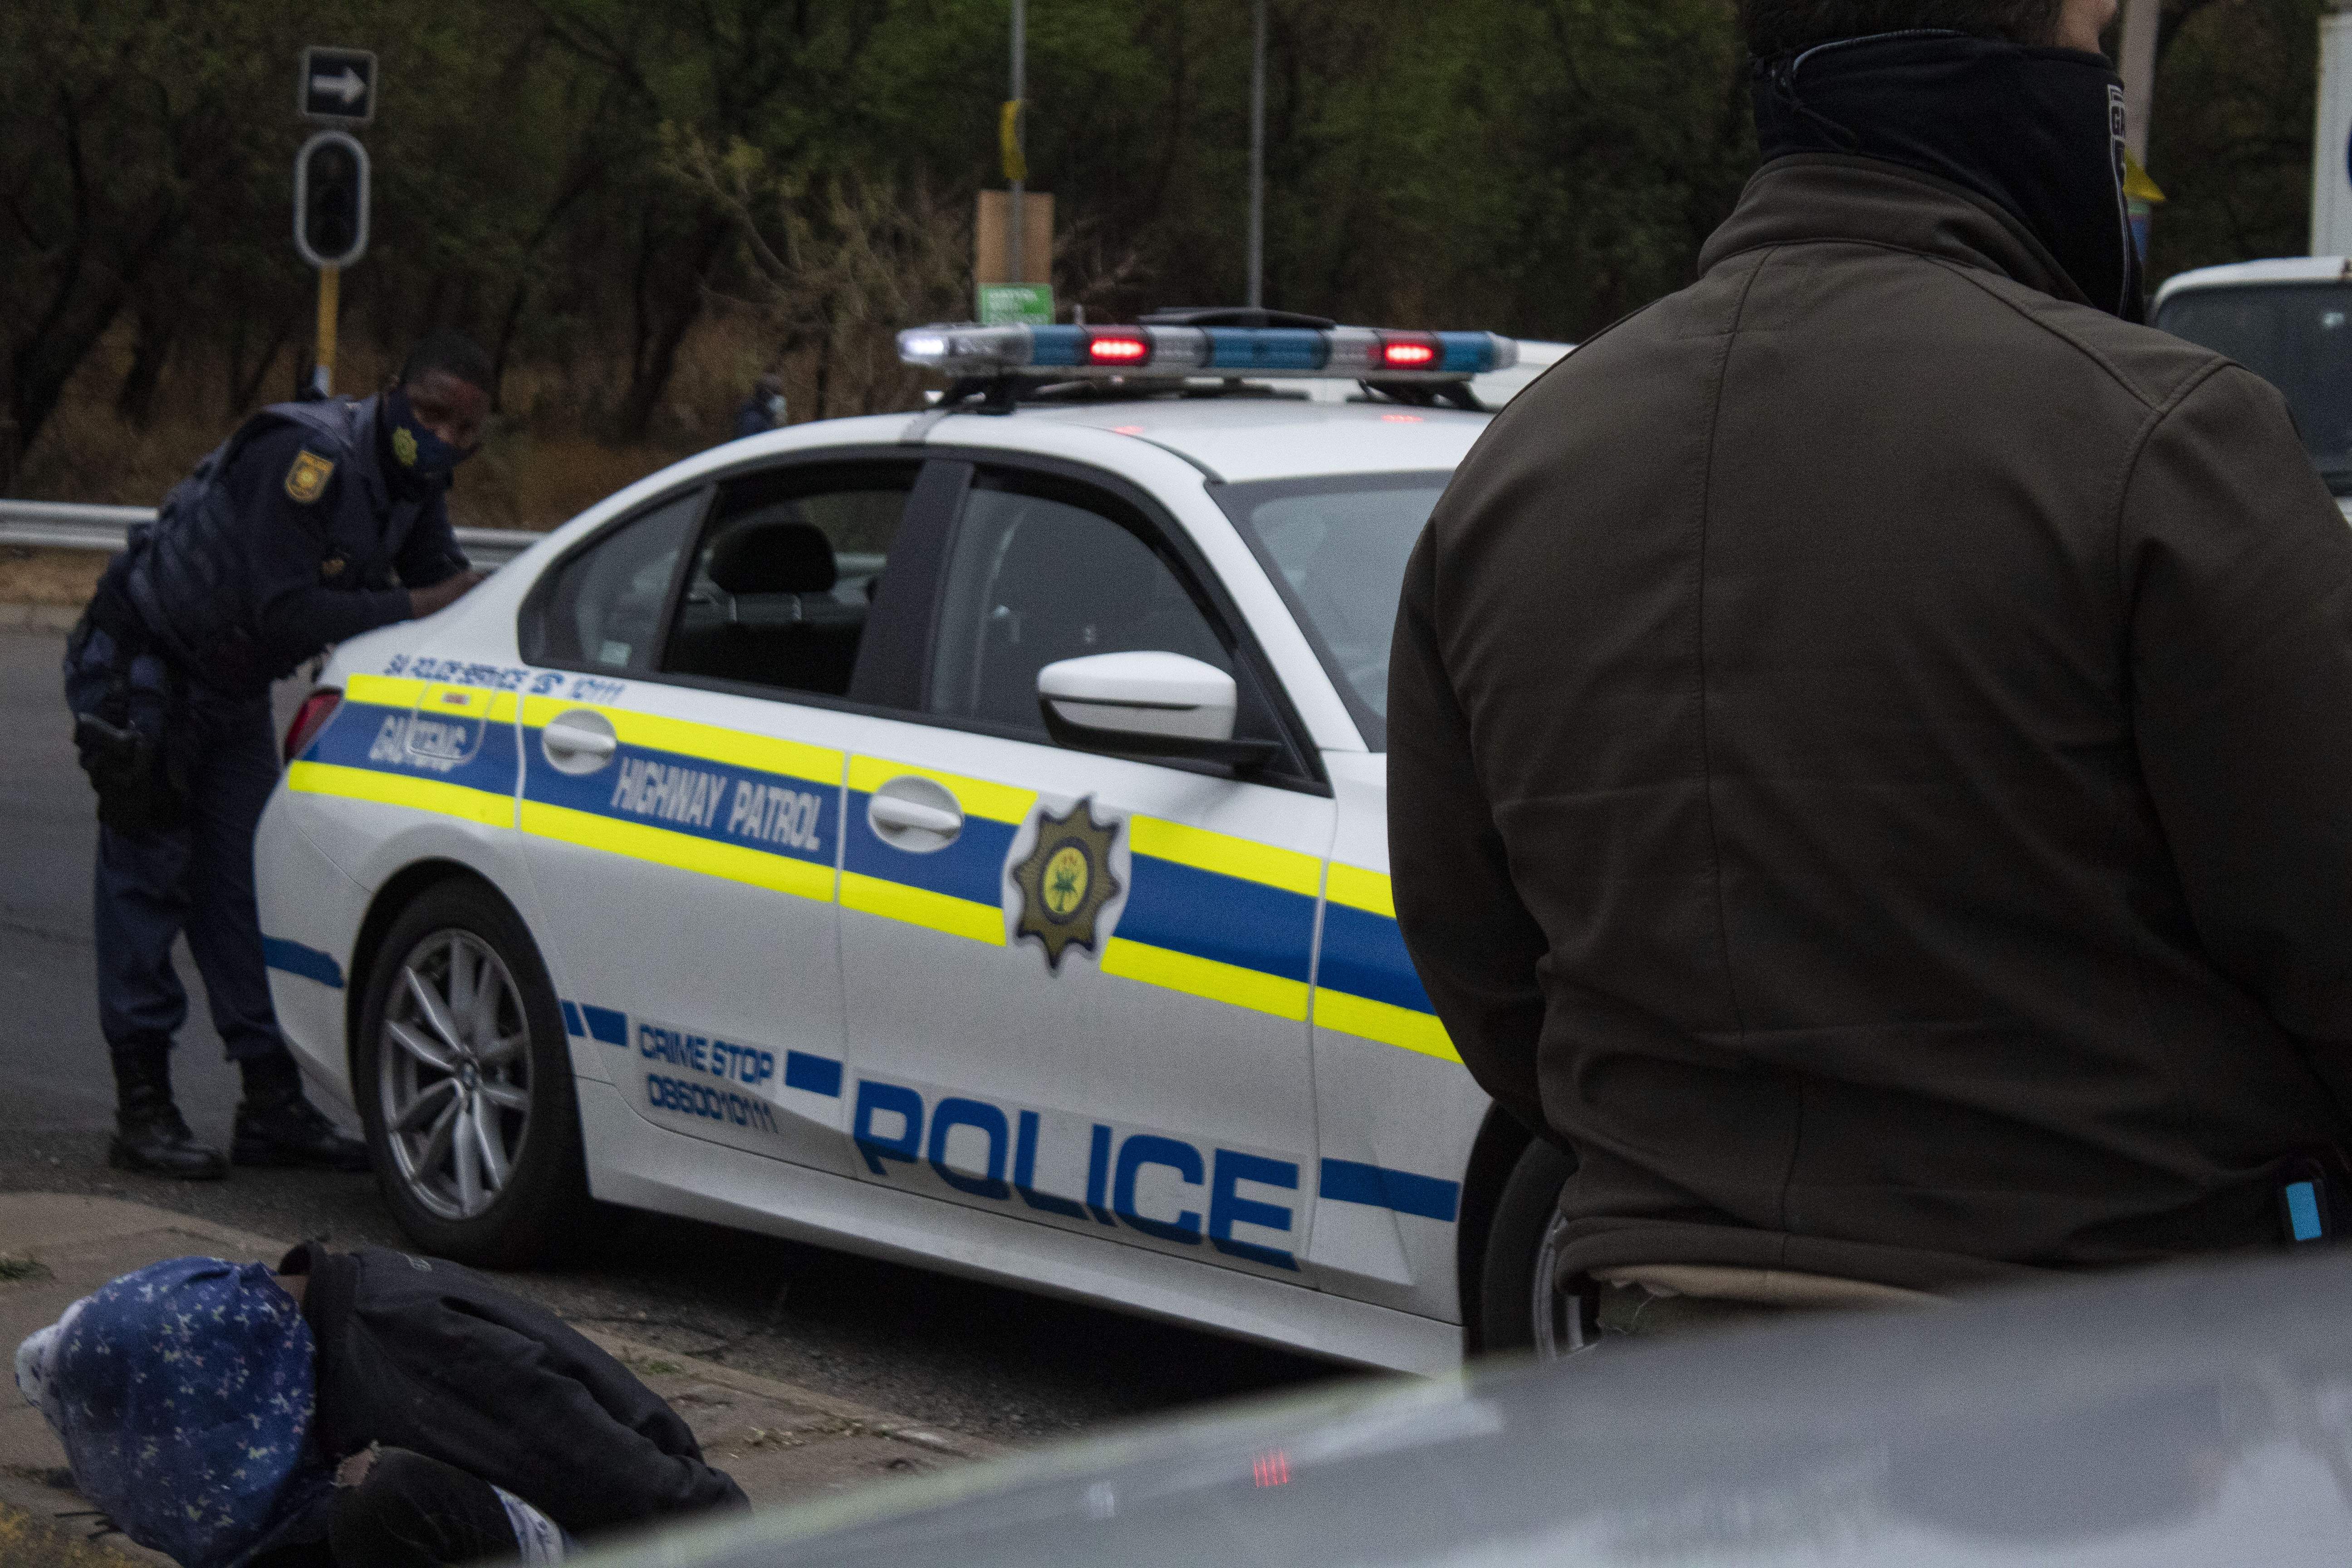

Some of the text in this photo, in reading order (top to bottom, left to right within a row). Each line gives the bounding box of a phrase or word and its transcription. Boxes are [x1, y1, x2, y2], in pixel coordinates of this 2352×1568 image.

[612, 757, 820, 851] HIGHWAY PATROL
[639, 1024, 774, 1084] CRIME STOP
[853, 1079, 1300, 1271] POLICE
